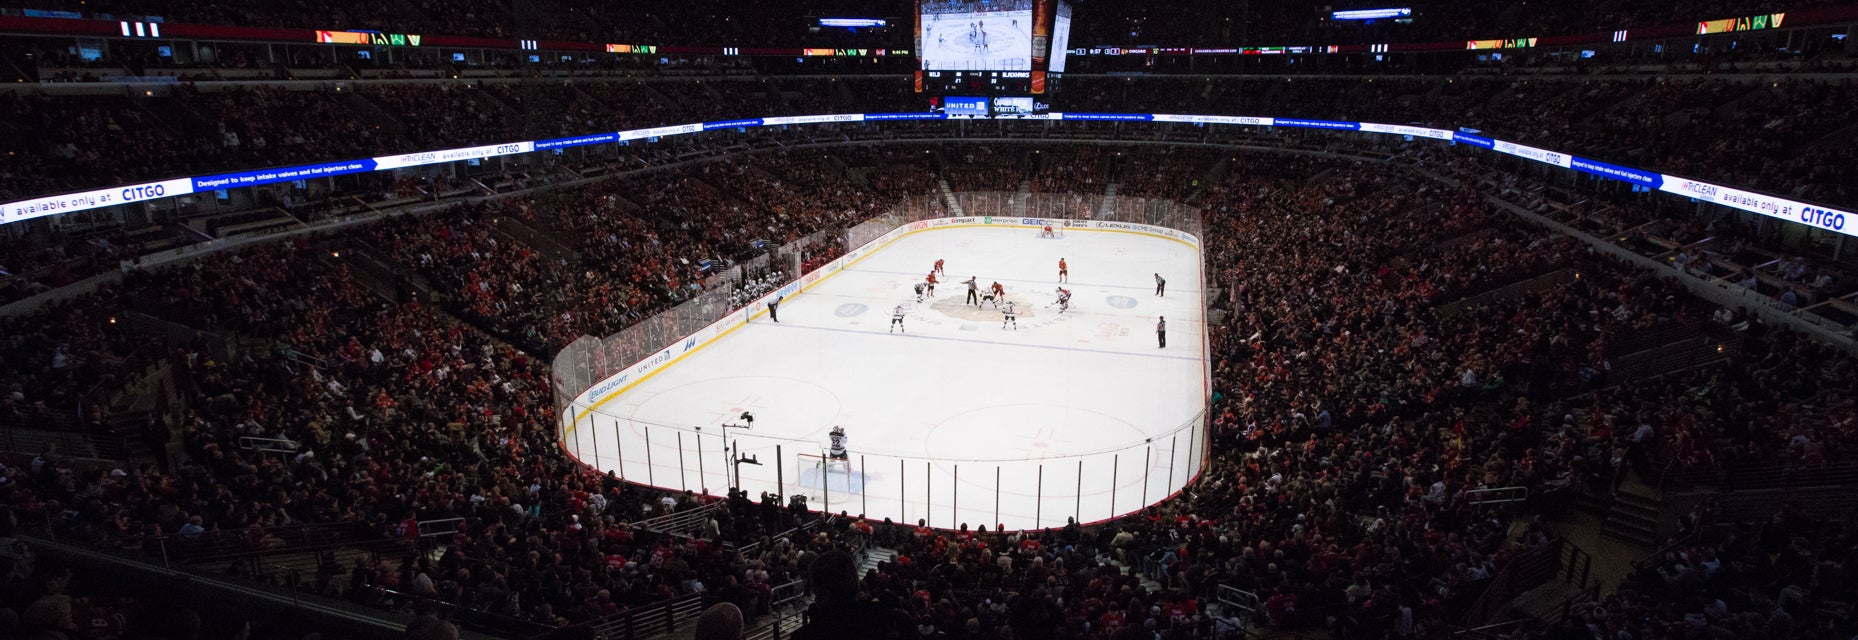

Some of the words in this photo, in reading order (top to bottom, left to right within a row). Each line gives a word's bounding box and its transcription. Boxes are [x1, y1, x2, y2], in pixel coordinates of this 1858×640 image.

[442, 151, 470, 159] available
[472, 149, 484, 157] only
[496, 144, 520, 154] CITGO
[197, 178, 229, 188] Designed
[240, 175, 255, 183] keep
[257, 172, 276, 180] intake
[299, 168, 310, 176] and
[324, 165, 347, 173] injectors
[16, 197, 67, 216] available
[71, 196, 96, 208] only
[100, 193, 112, 202] at
[122, 184, 165, 201] CITGO
[1723, 192, 1758, 208] available
[1761, 200, 1779, 214] only
[1782, 205, 1793, 216] at
[1800, 206, 1846, 230] CITGO
[913, 219, 928, 231] WGN
[637, 355, 664, 374] UNITED
[588, 384, 607, 401] BUD
[607, 374, 628, 391] LIGHT
